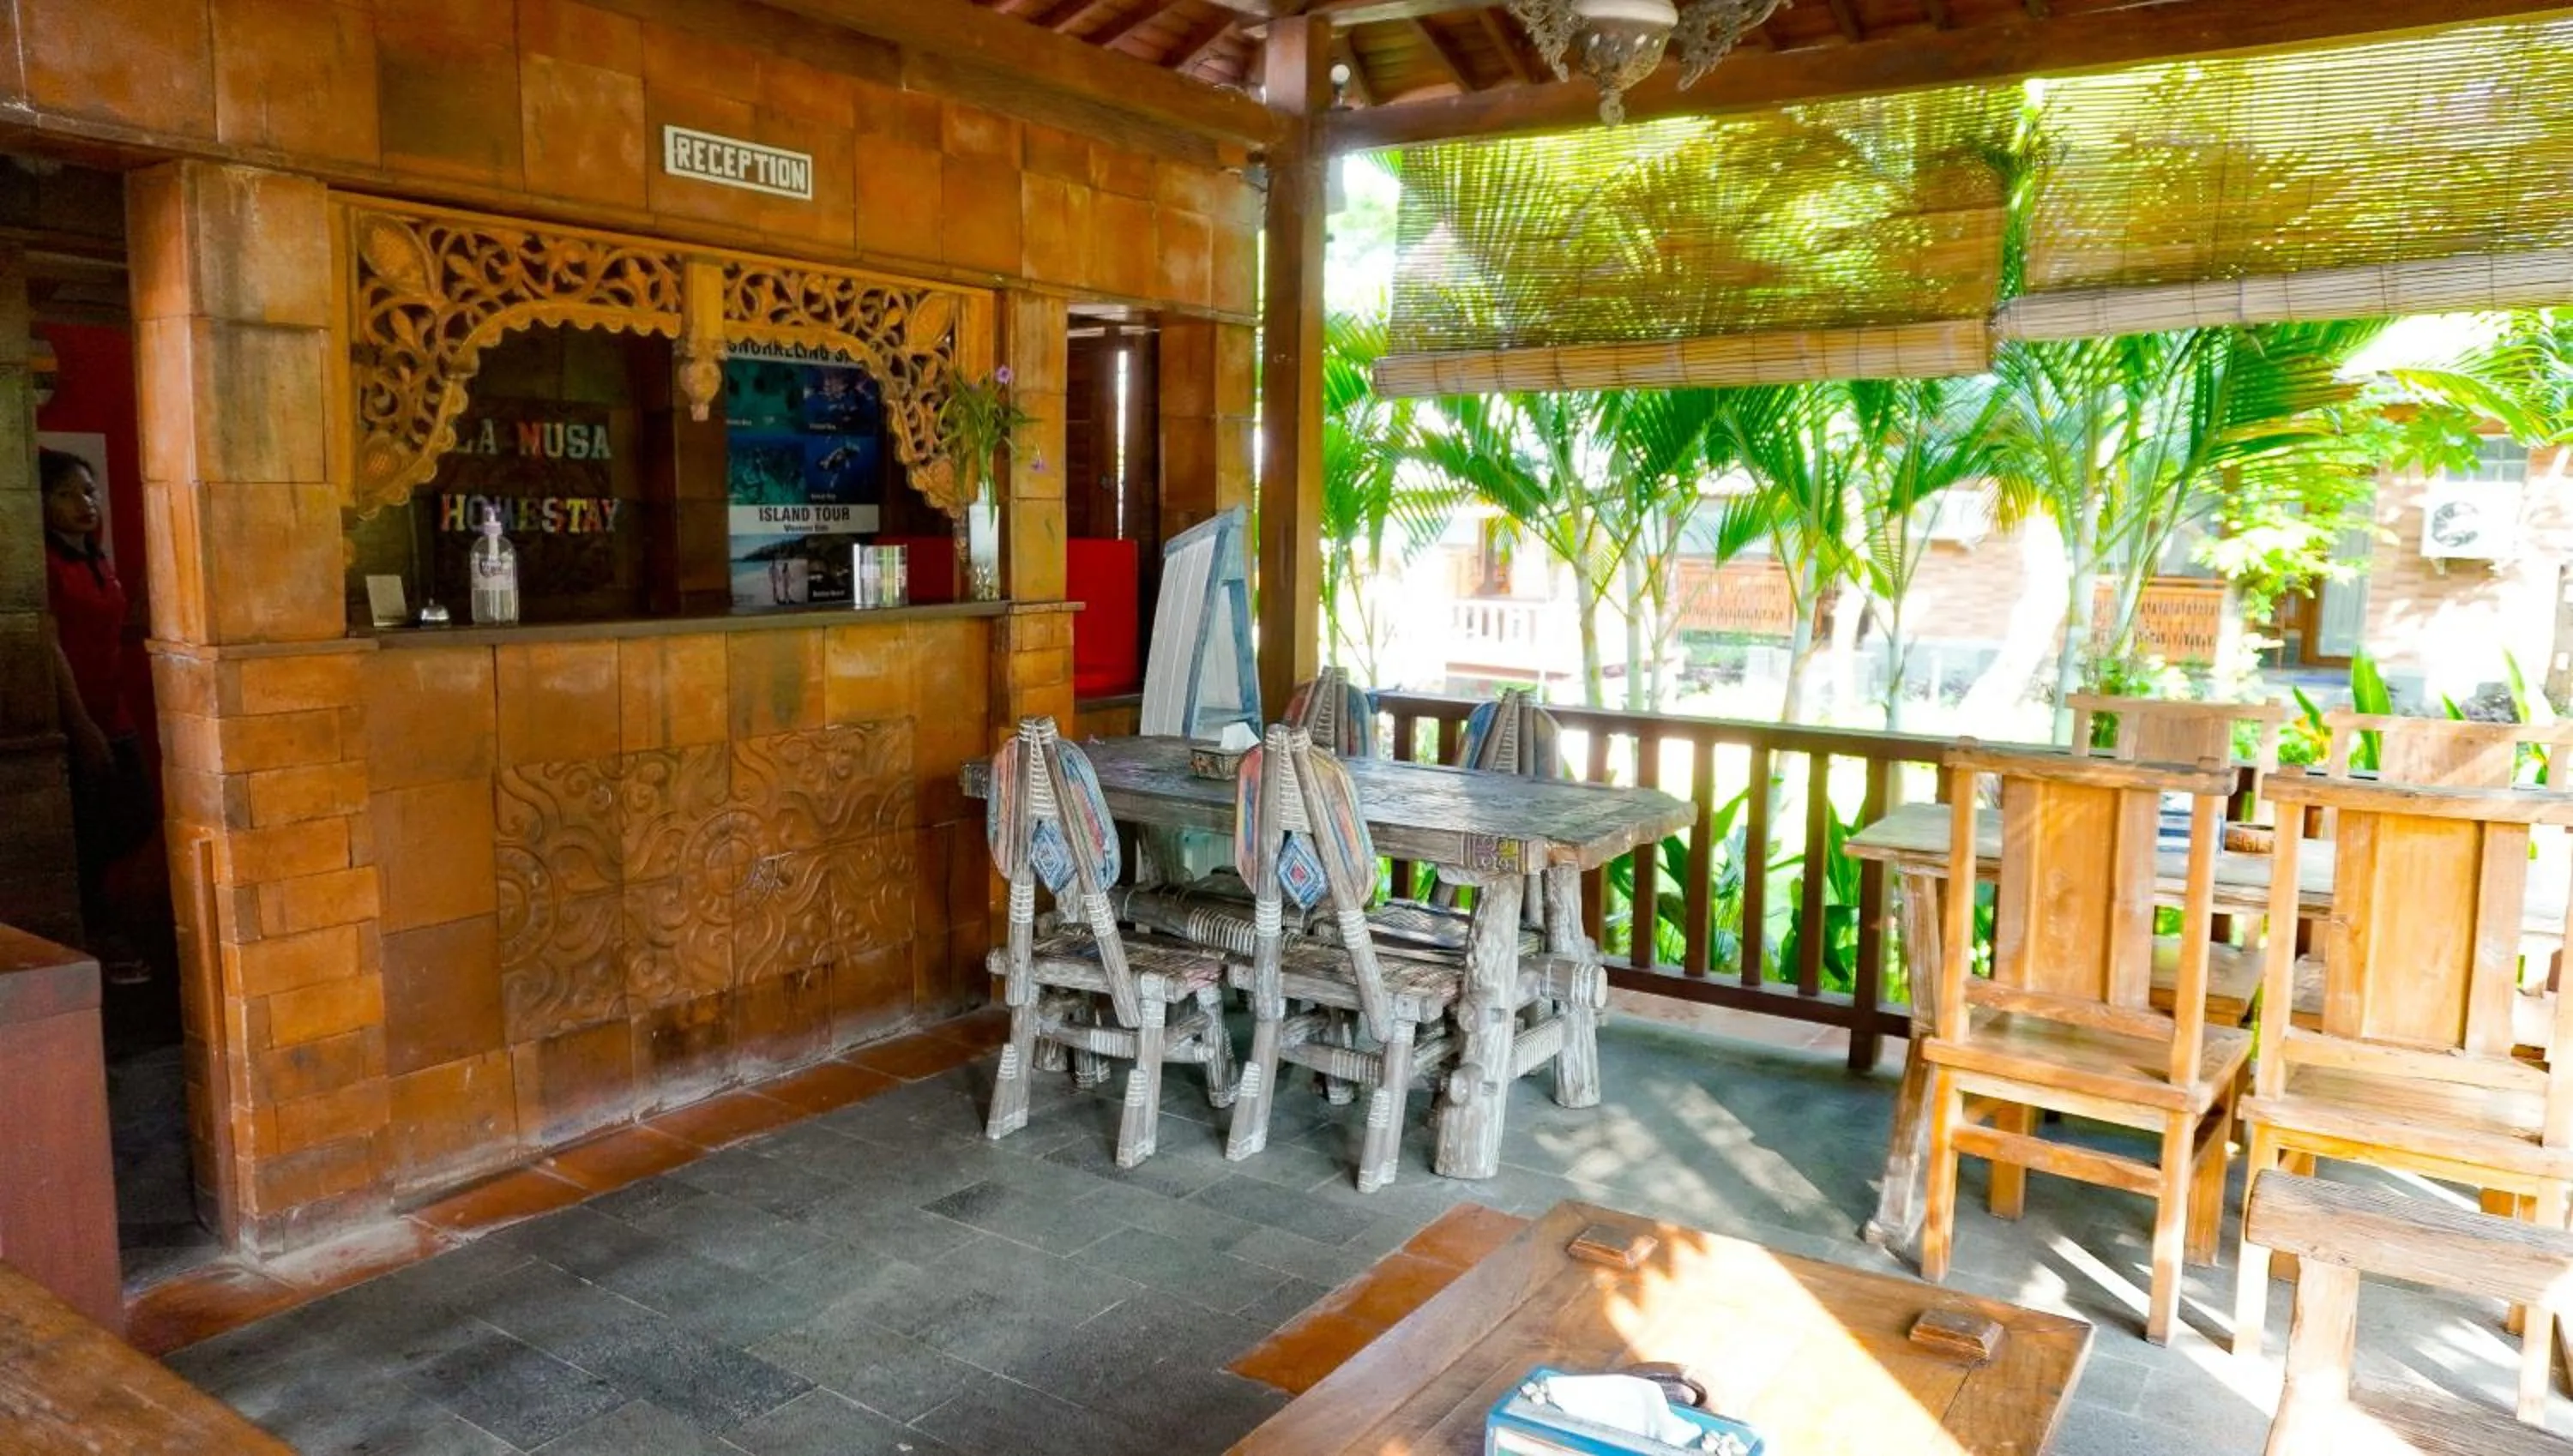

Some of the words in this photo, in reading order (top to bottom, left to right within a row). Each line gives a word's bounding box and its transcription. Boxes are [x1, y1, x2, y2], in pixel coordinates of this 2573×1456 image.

[676, 136, 805, 190] RECEPTION
[759, 507, 810, 522] ISLAND
[815, 507, 850, 521] TOUR
